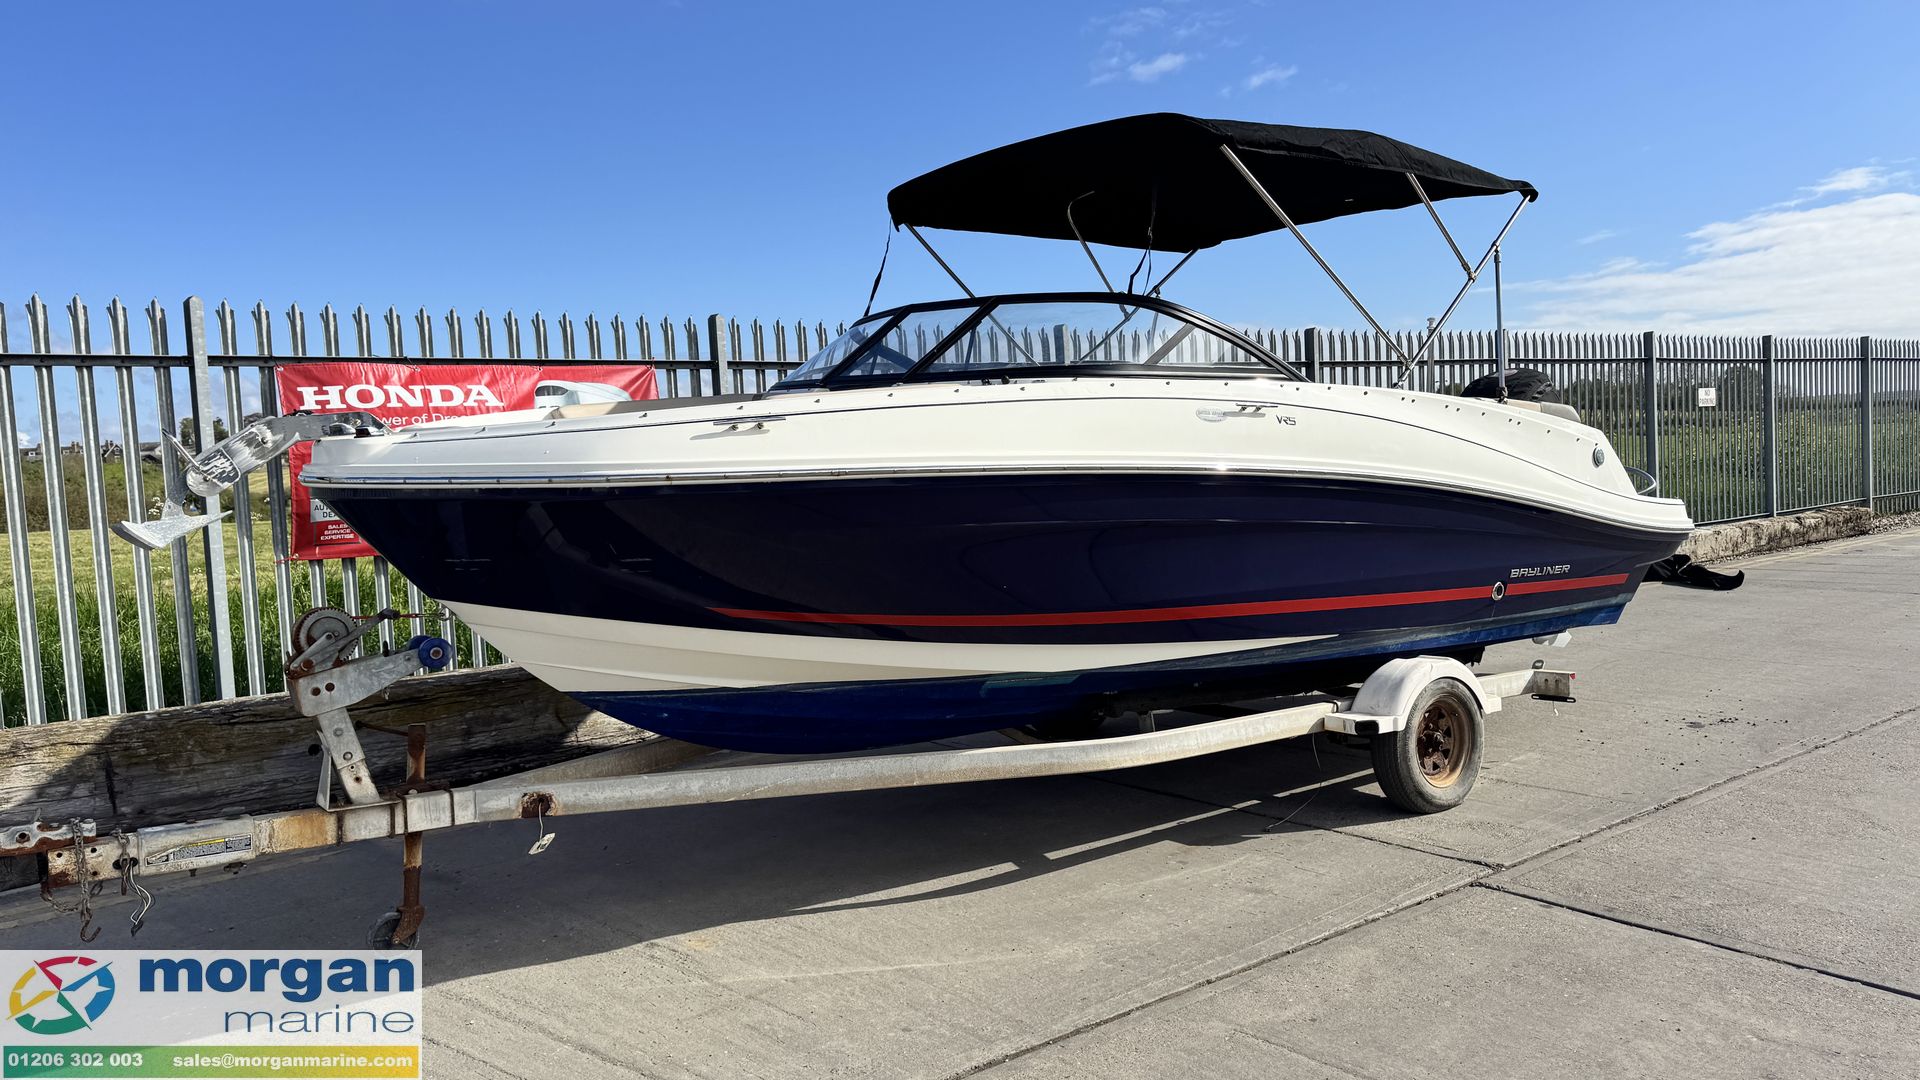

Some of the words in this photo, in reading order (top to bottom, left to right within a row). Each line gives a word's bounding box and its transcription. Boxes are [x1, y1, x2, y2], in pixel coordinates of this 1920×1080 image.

[297, 384, 504, 410] HONDA
[412, 413, 428, 424] of
[1510, 564, 1571, 578] BAYLINER
